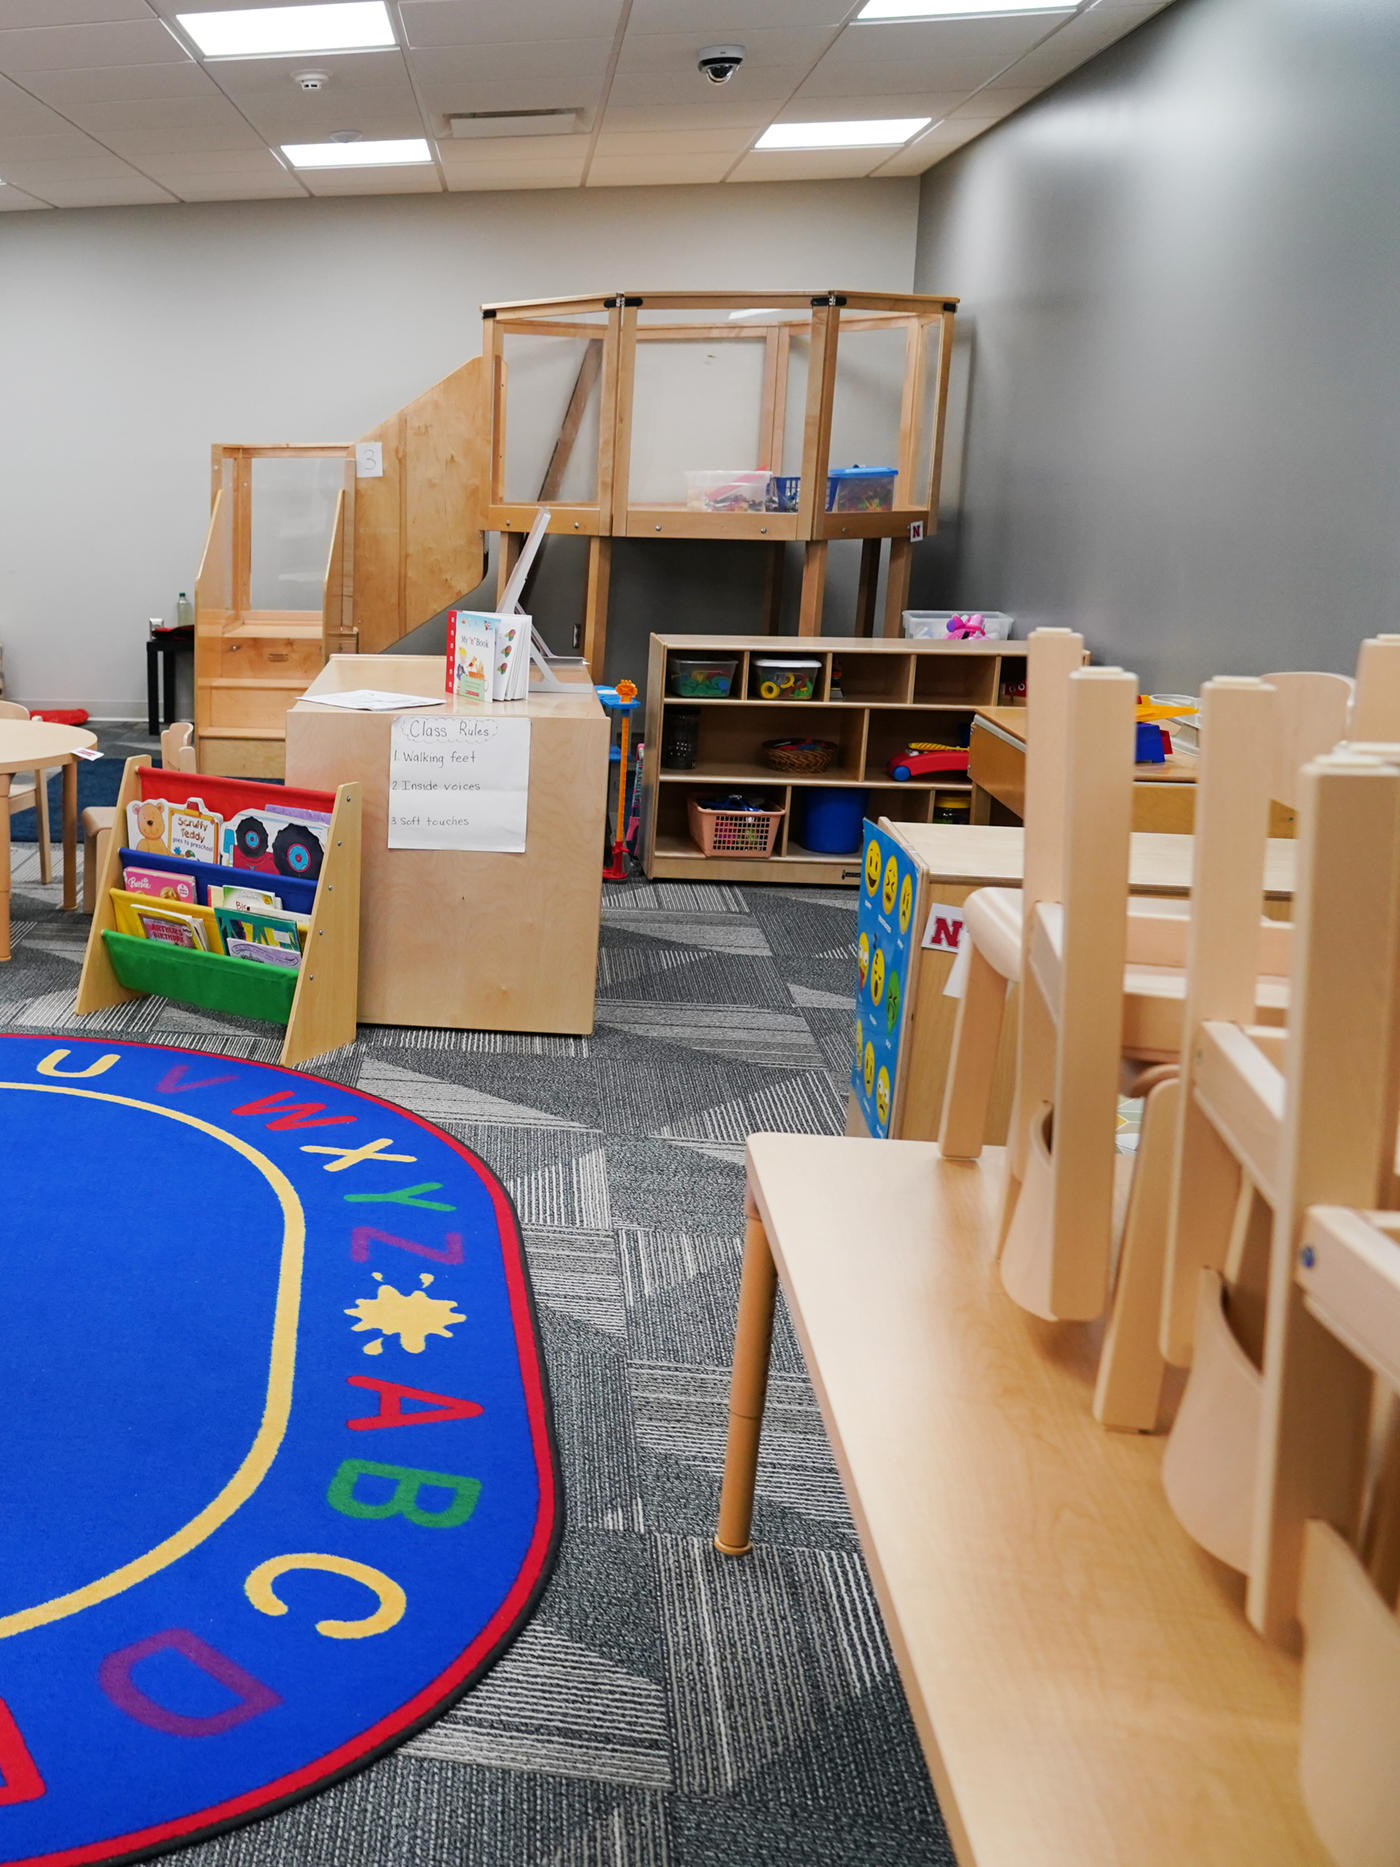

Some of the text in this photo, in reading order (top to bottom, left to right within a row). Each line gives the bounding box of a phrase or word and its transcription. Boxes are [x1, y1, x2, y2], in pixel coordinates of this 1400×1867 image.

[363, 449, 377, 470] 3
[912, 524, 921, 539] N
[476, 637, 489, 649] Book
[409, 719, 490, 738] Class Rules
[403, 750, 444, 769] Walking
[450, 750, 476, 763] feet
[401, 779, 438, 791] Inside
[444, 781, 481, 791] voices
[177, 816, 208, 832] Scruffy
[400, 815, 420, 826] Soft
[427, 815, 470, 826] touches
[171, 836, 183, 844] goes
[190, 841, 214, 852] preschool
[180, 827, 206, 844] Teddy
[128, 876, 151, 889] Barbie
[930, 916, 963, 948] N
[37, 1049, 120, 1077] U
[156, 1065, 238, 1093] V
[231, 1091, 357, 1130] W
[300, 1138, 417, 1172] X
[344, 1182, 456, 1211] Y
[351, 1226, 464, 1265] Z
[346, 1375, 484, 1431] A
[327, 1459, 482, 1528] B
[244, 1553, 406, 1639] C
[99, 1628, 283, 1738] D
